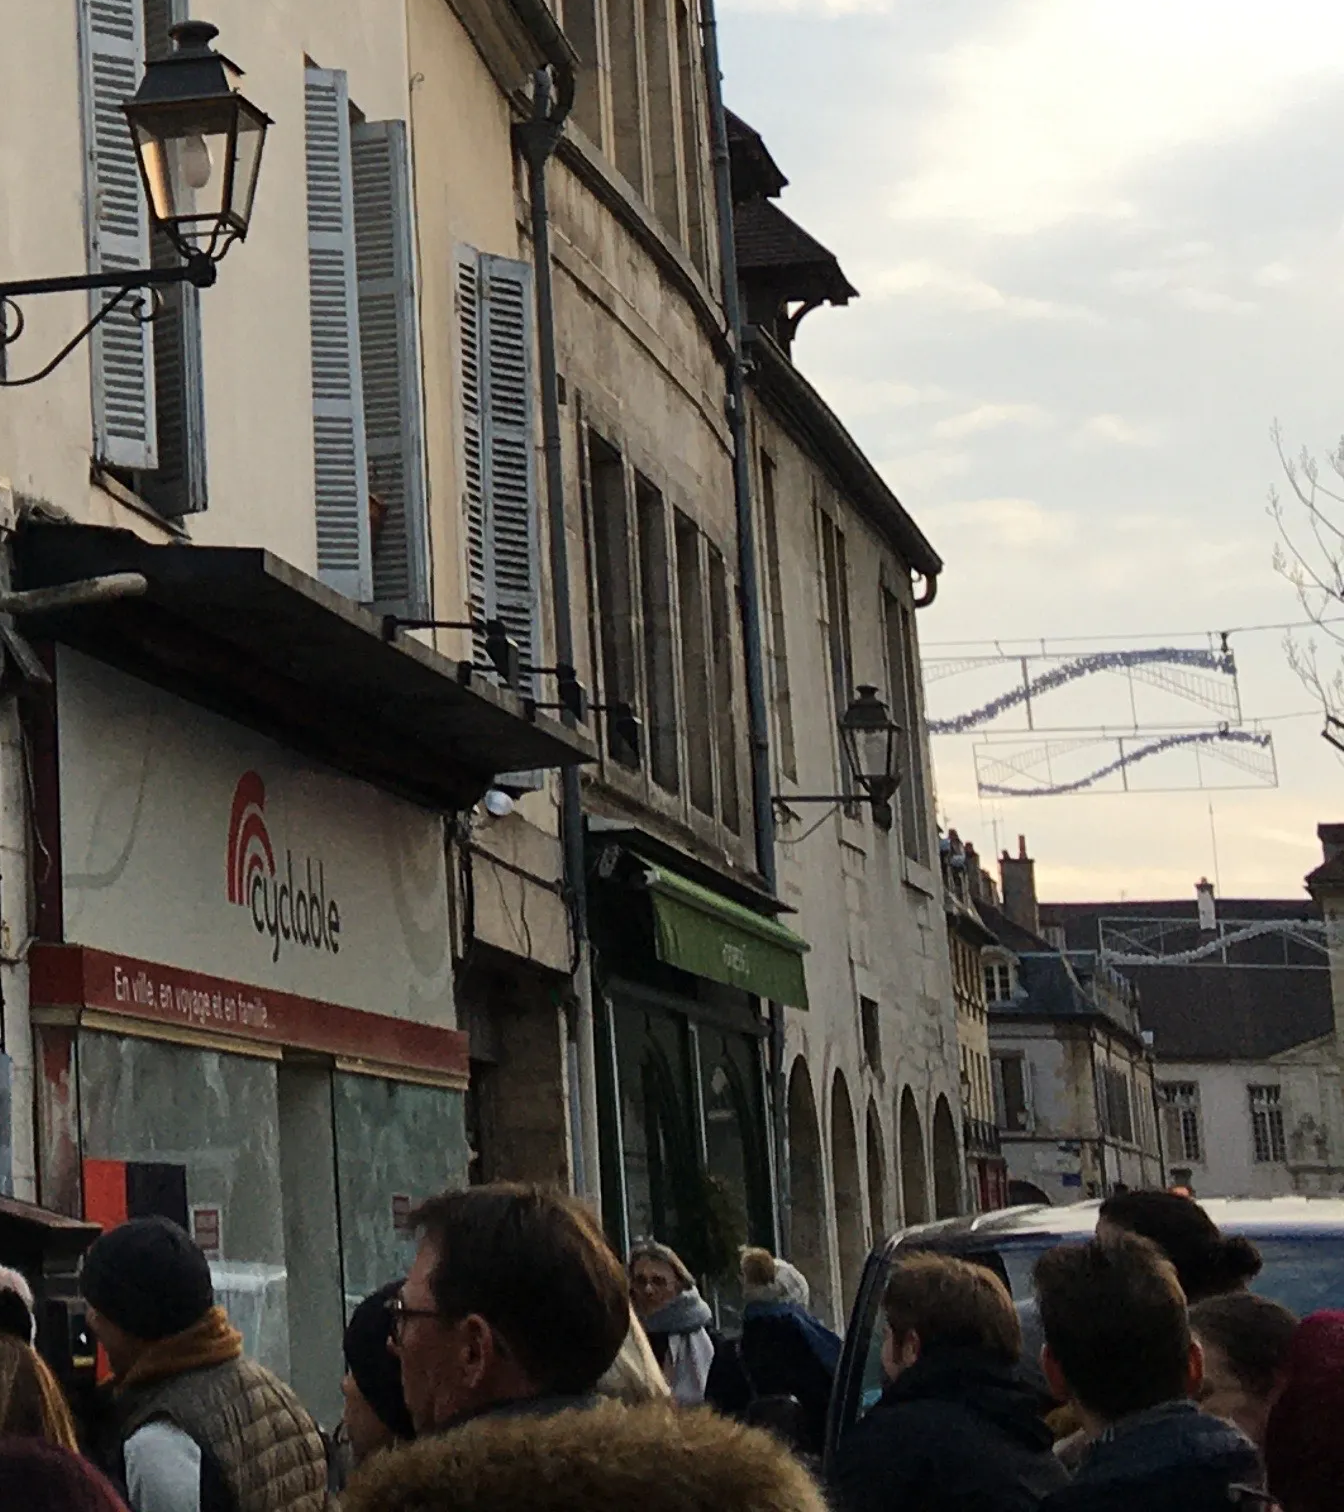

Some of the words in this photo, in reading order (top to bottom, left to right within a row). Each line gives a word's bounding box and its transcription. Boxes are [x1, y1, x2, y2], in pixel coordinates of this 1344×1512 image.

[251, 849, 340, 964] cyclable
[114, 966, 131, 1002] En
[160, 983, 174, 1010] en
[175, 986, 211, 1025] voyage
[212, 990, 223, 1020] et
[224, 996, 237, 1022] en
